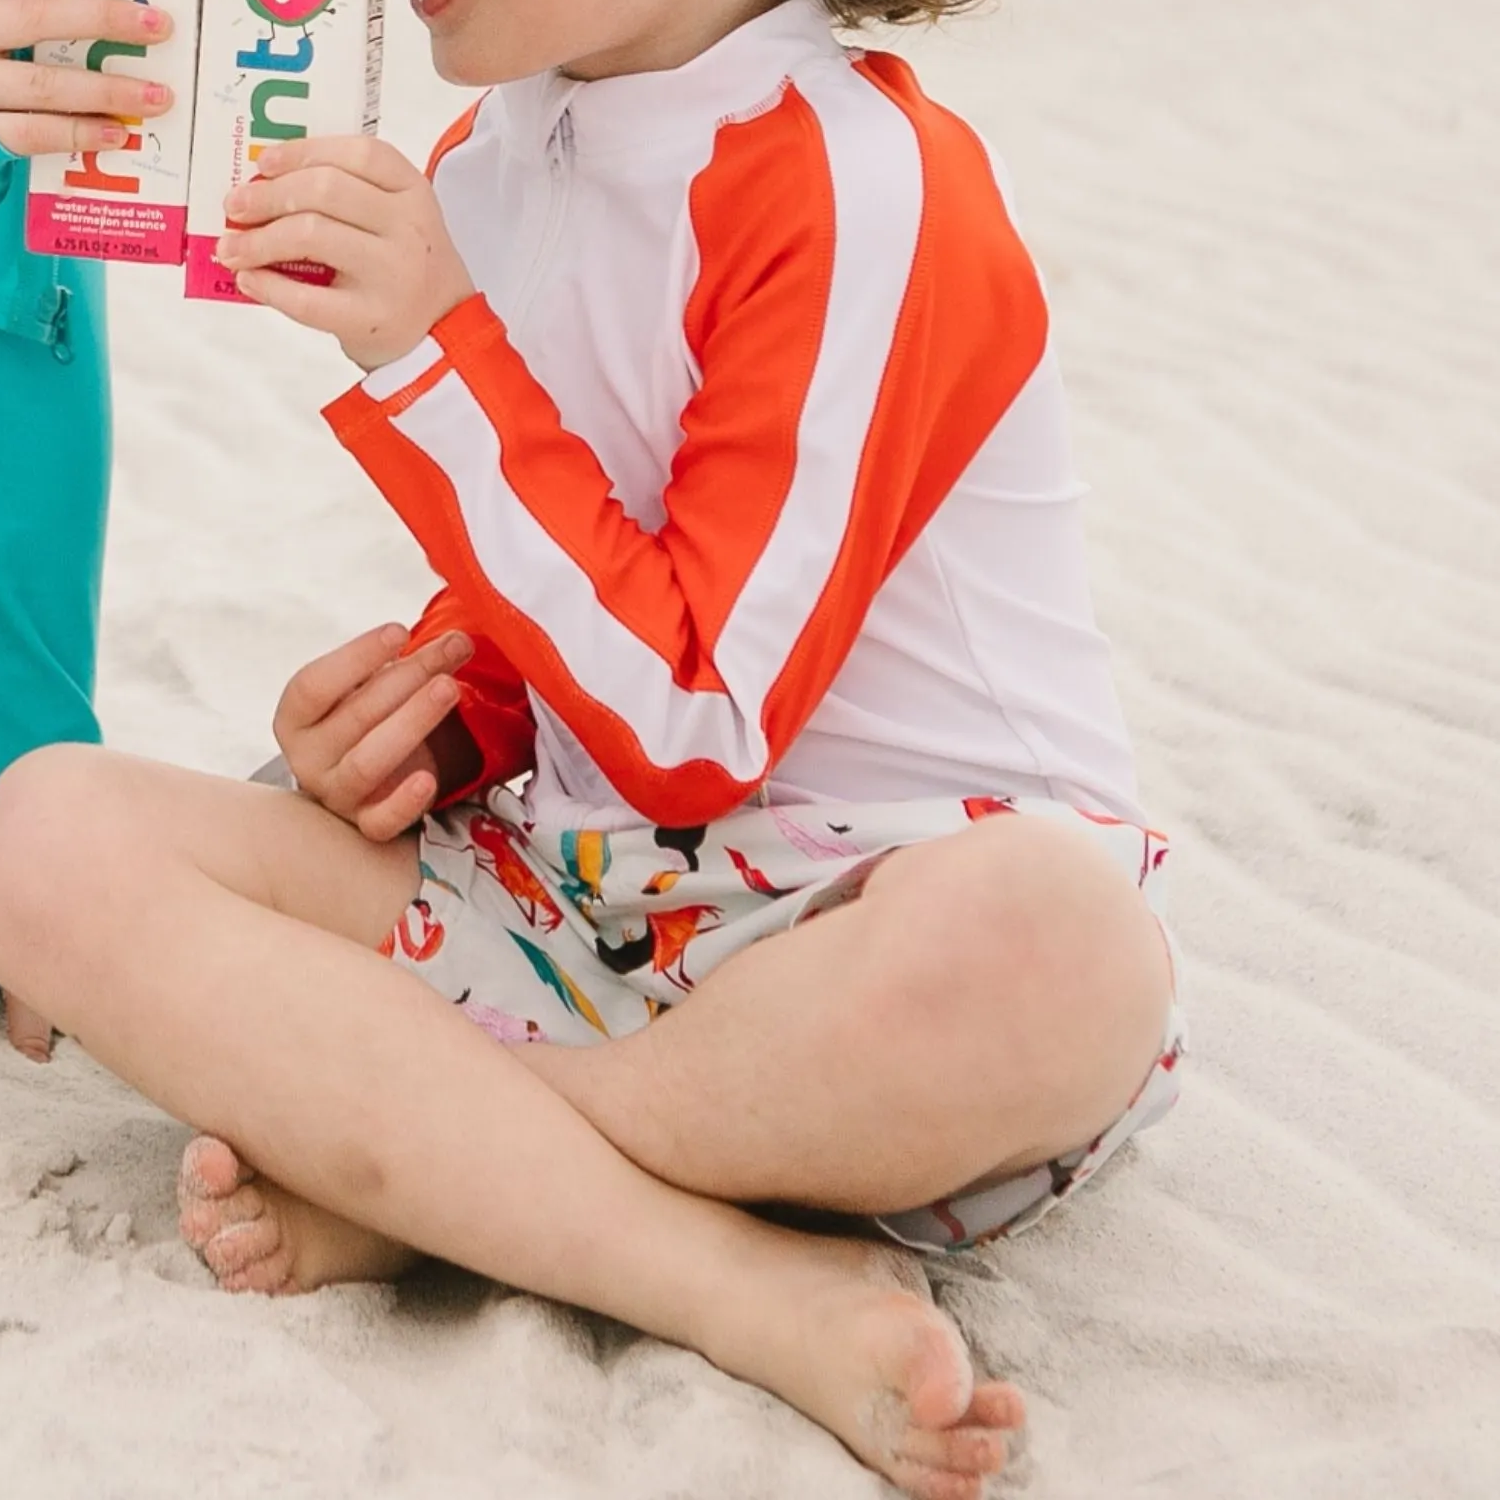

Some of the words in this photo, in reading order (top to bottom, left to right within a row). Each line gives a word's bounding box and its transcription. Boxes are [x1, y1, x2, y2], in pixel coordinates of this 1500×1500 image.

[231, 115, 244, 187] termelon
[54, 201, 87, 213] water
[90, 204, 135, 217] infused
[137, 209, 163, 220] with
[51, 211, 120, 228] watermelon
[123, 219, 167, 231] essence
[54, 237, 77, 250] 6.75
[79, 239, 90, 251] FL
[92, 241, 109, 253] OZ
[120, 243, 142, 255] 200
[144, 246, 159, 258] mL
[281, 262, 325, 275] essence
